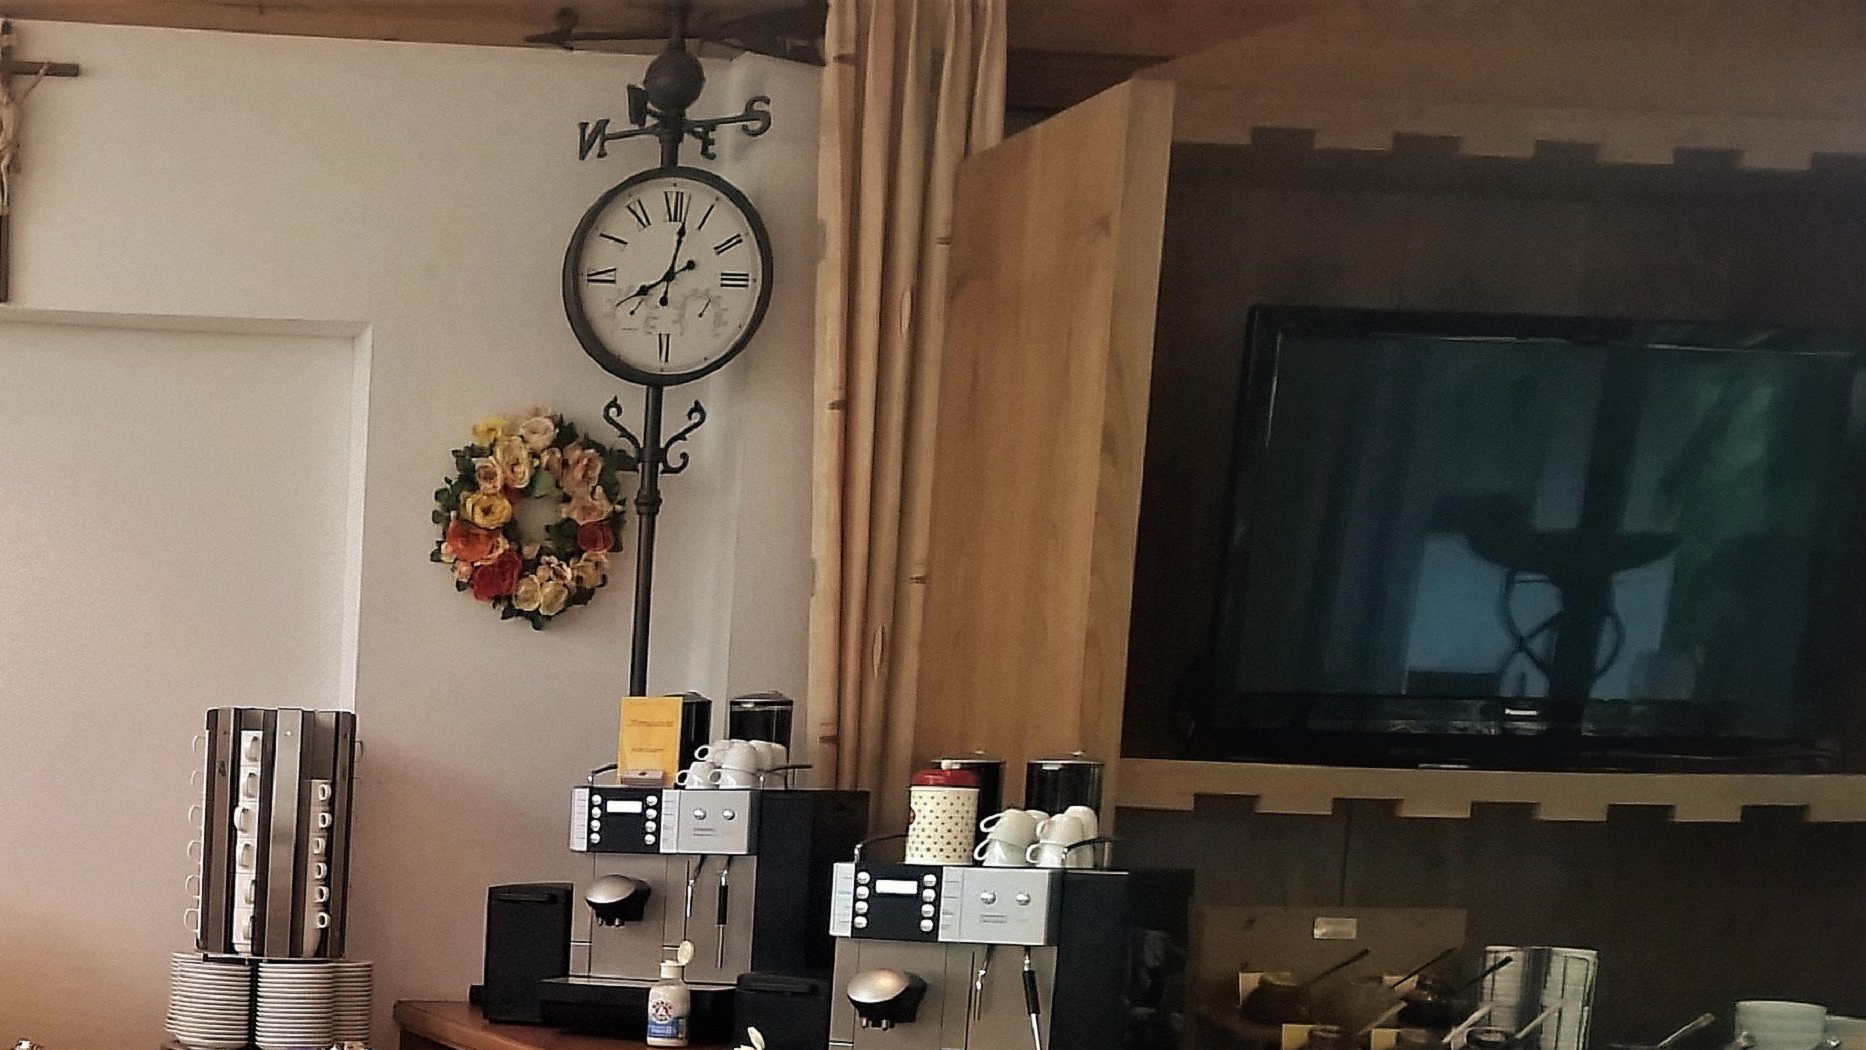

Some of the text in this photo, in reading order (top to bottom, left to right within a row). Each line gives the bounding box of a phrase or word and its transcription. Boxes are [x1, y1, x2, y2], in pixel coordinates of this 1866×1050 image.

[742, 95, 772, 137] S
[713, 233, 743, 256] II
[720, 272, 750, 288] III
